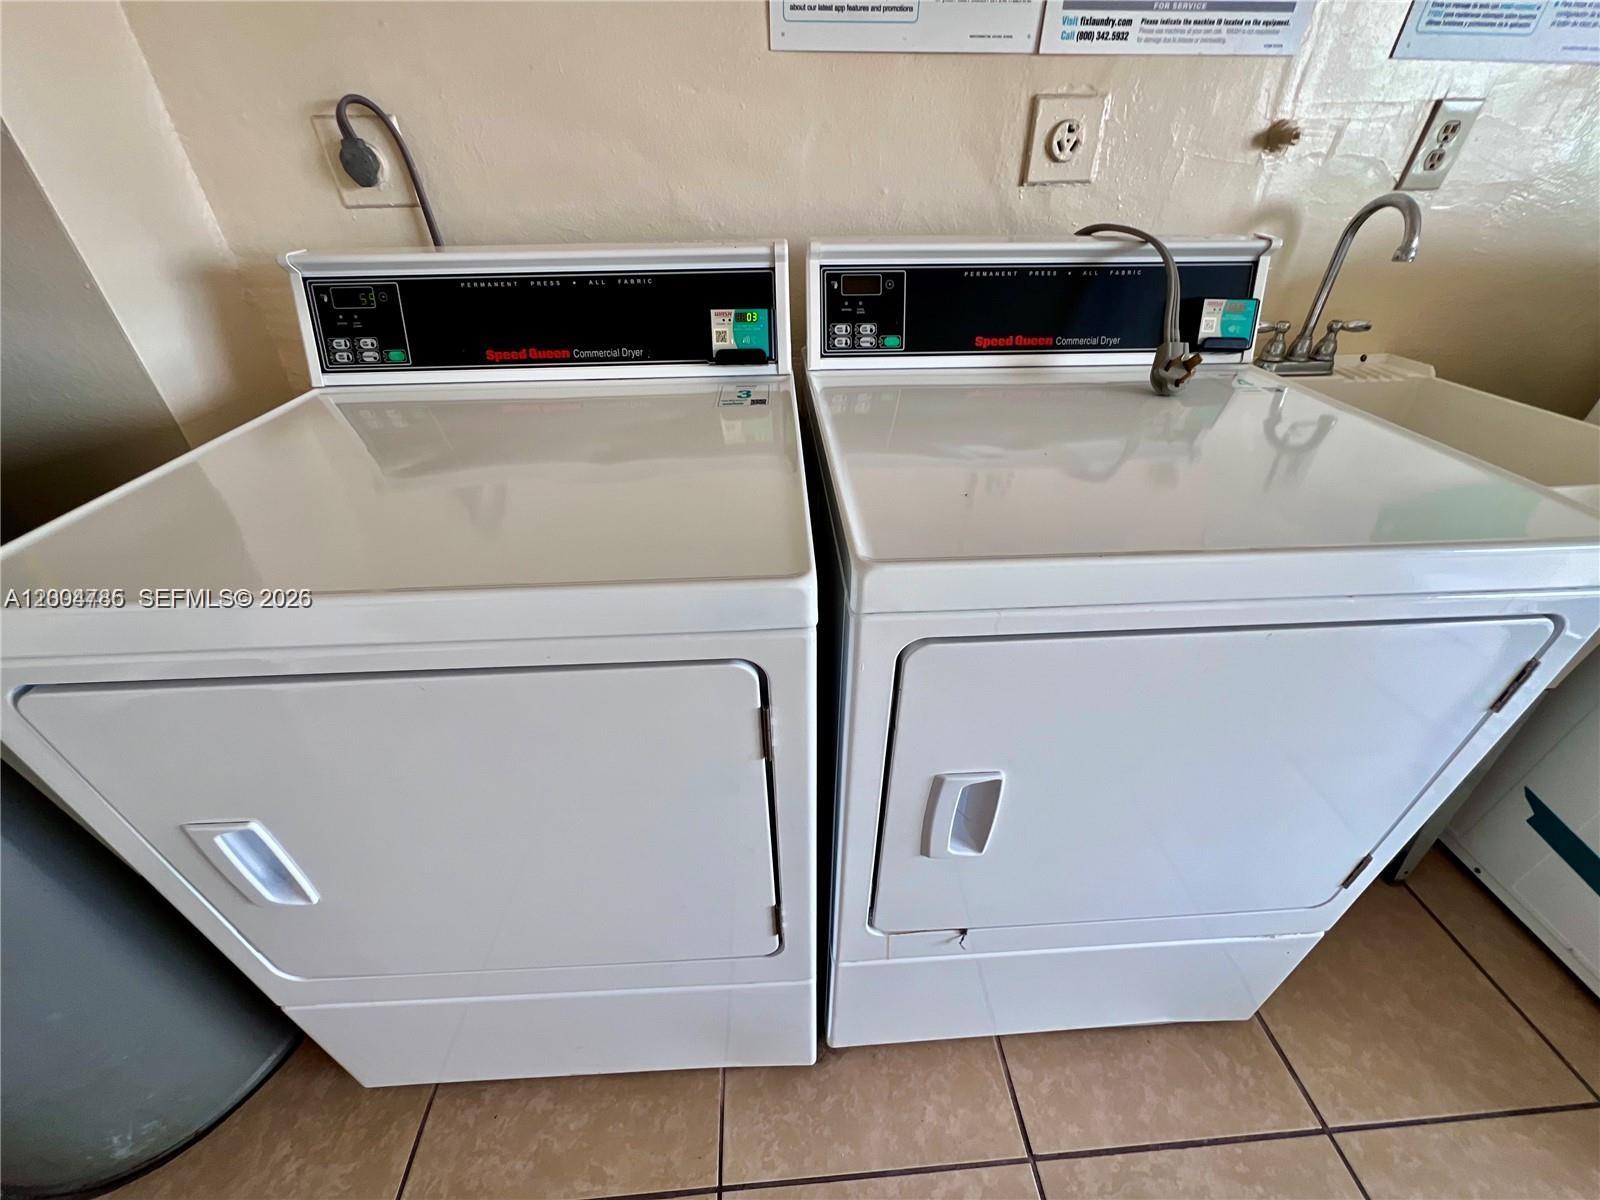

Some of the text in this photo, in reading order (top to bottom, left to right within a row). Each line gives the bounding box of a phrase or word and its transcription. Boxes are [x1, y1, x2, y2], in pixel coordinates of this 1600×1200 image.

[834, 5, 845, 13] app
[847, 4, 869, 12] features
[882, 5, 914, 13] promotions
[1153, 2, 1207, 10] FOR SERVICE
[1062, 16, 1133, 28] Visit fixlaundry.com
[1193, 18, 1215, 26] machine
[1223, 18, 1244, 26] located
[1060, 31, 1129, 42] Call (800) 342.5932
[746, 312, 758, 322] 03
[975, 335, 1121, 348] Speed Queen Commercial Dryer
[486, 347, 643, 361] Speed Queen Commercial Dryer
[737, 390, 752, 399] 3
